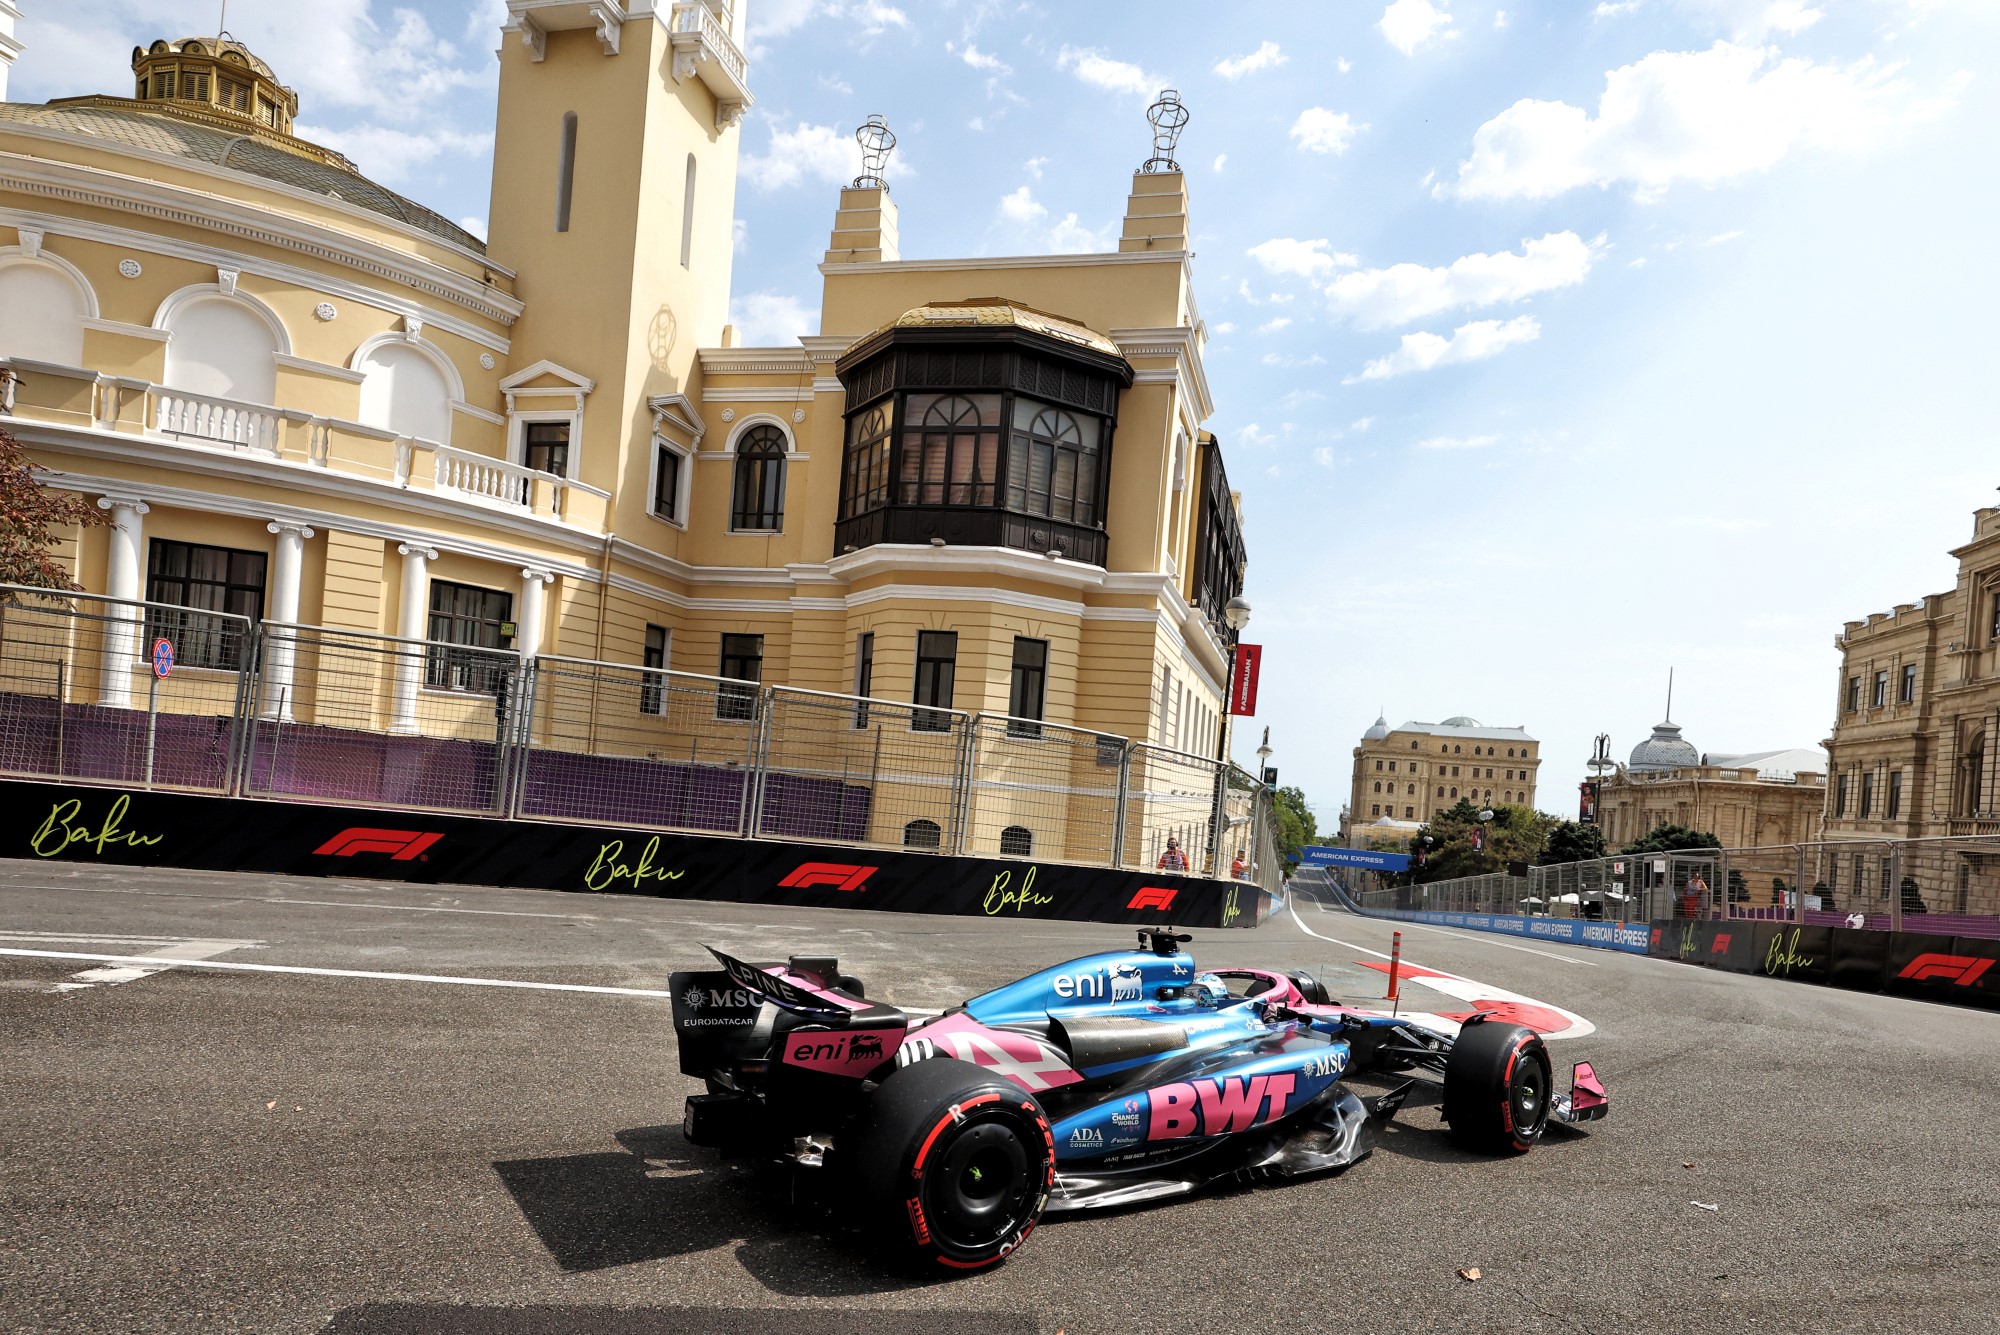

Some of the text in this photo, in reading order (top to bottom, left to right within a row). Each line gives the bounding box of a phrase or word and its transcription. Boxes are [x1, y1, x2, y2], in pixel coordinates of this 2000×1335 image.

[31, 794, 163, 857] Baku
[584, 835, 685, 891] Baku
[1311, 851, 1384, 864] AMERICAN EXPRESS
[983, 865, 1054, 915] Baku
[1494, 919, 1524, 932] AMERICAN EXPRESS
[1530, 921, 1573, 938] AMERICAN EXPRESS
[1582, 926, 1648, 947] AMERICAN EXPRESS
[1765, 928, 1813, 975] Baku
[1053, 967, 1105, 998] eni
[684, 1018, 754, 1027] EURODATACAR
[793, 1037, 847, 1062] eni
[1315, 1052, 1347, 1077] MSC
[1147, 1073, 1297, 1142] BWT
[1070, 1128, 1104, 1141] ADA
[1117, 1119, 1140, 1127] WORLD
[1021, 1101, 1055, 1186] P ZERO
[906, 1197, 931, 1246] PIRELLI
